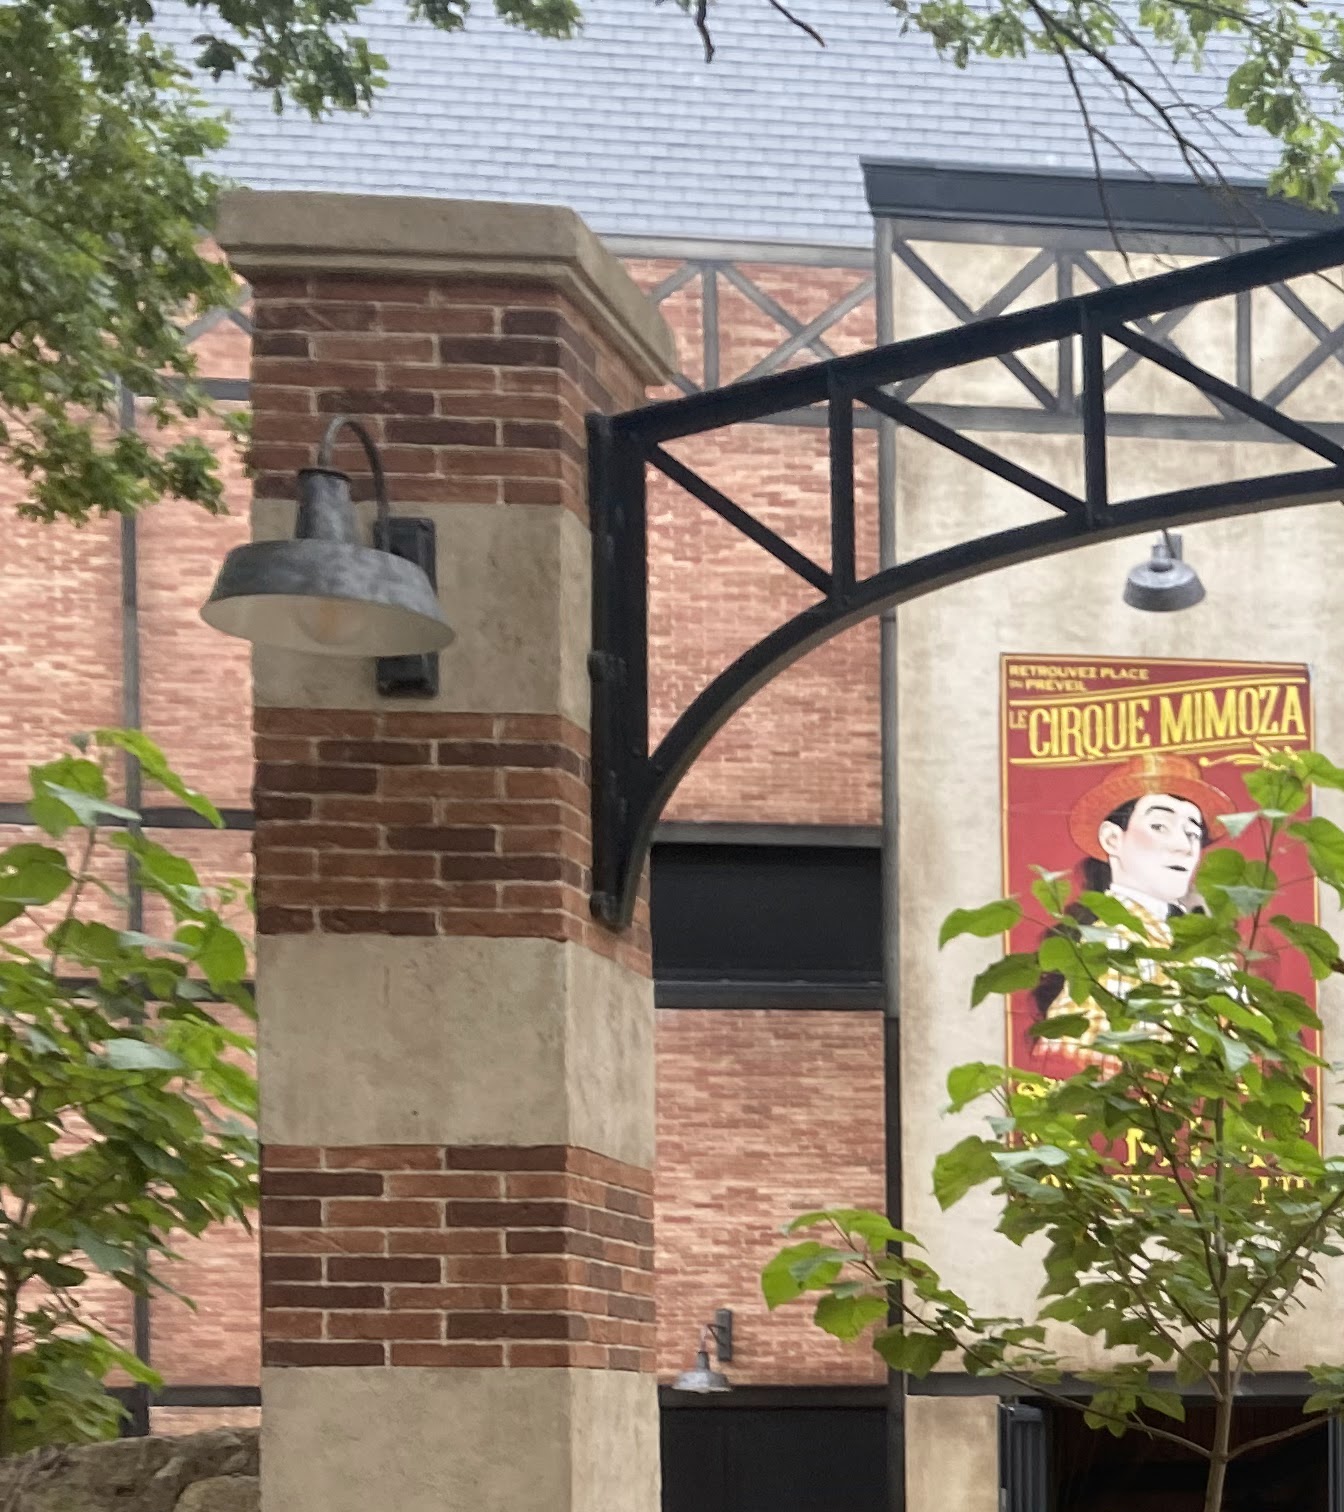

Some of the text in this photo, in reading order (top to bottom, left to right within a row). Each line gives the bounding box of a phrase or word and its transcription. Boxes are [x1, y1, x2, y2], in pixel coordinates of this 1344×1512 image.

[1100, 667, 1149, 680] PLACE
[1008, 685, 1307, 758] LE CIRQUE MIMOZA
